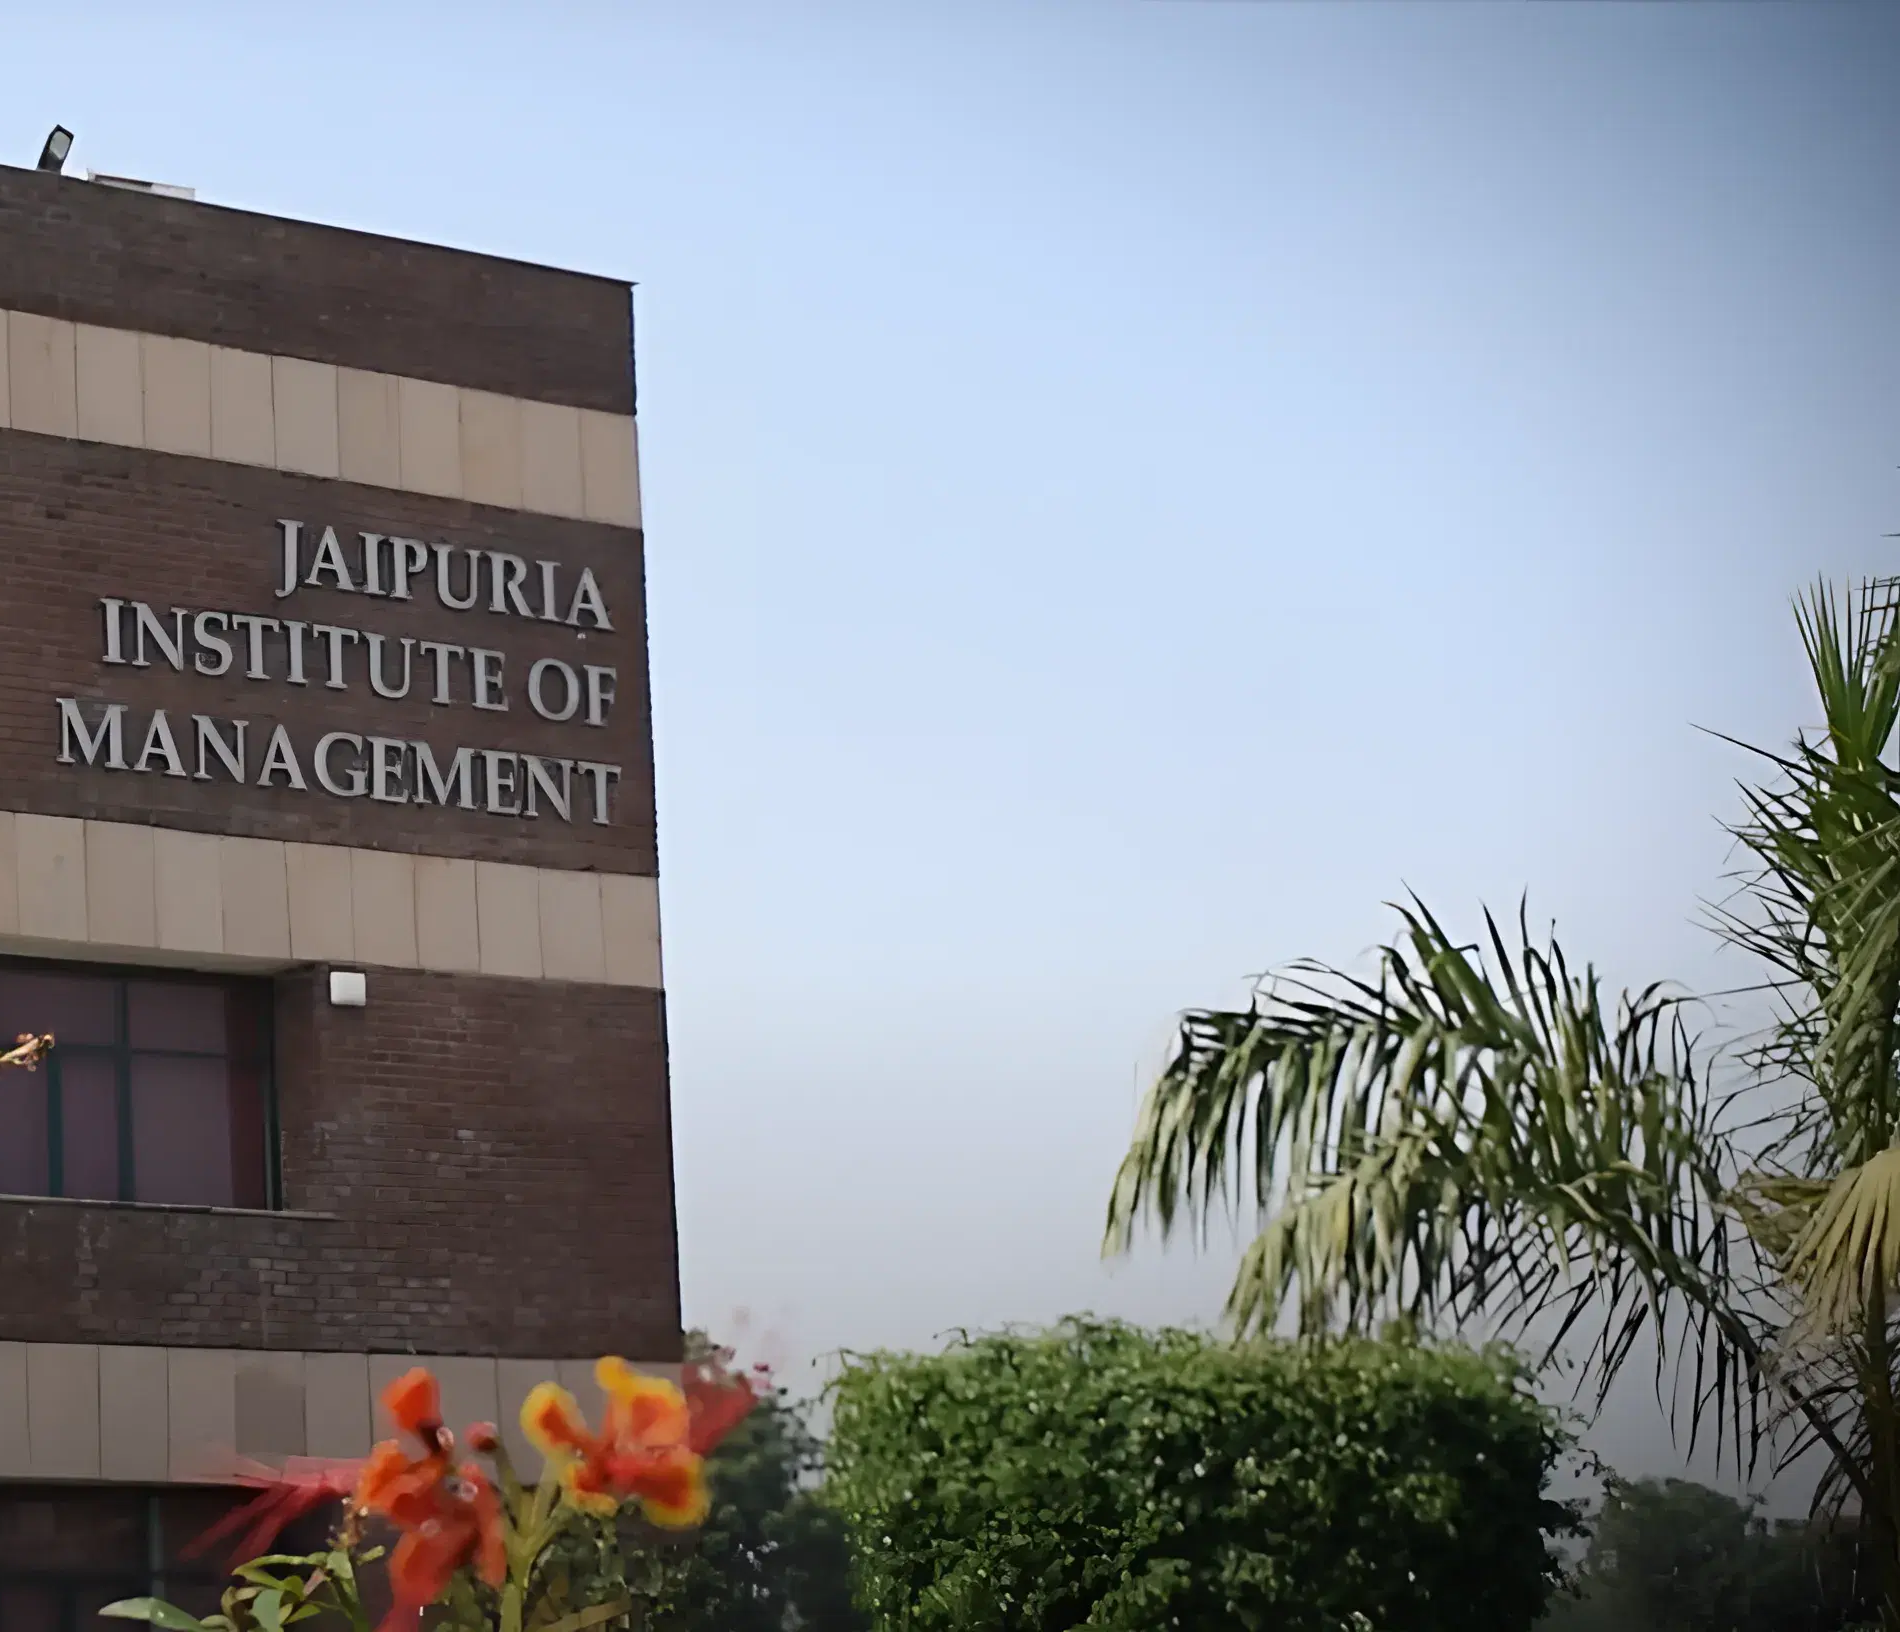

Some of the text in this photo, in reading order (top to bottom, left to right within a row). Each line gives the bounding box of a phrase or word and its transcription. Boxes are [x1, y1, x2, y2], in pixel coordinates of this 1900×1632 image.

[275, 518, 615, 632] JAIPURIA
[100, 597, 617, 727] INSTITUTE OF
[56, 697, 622, 826] MANAGEMENT
